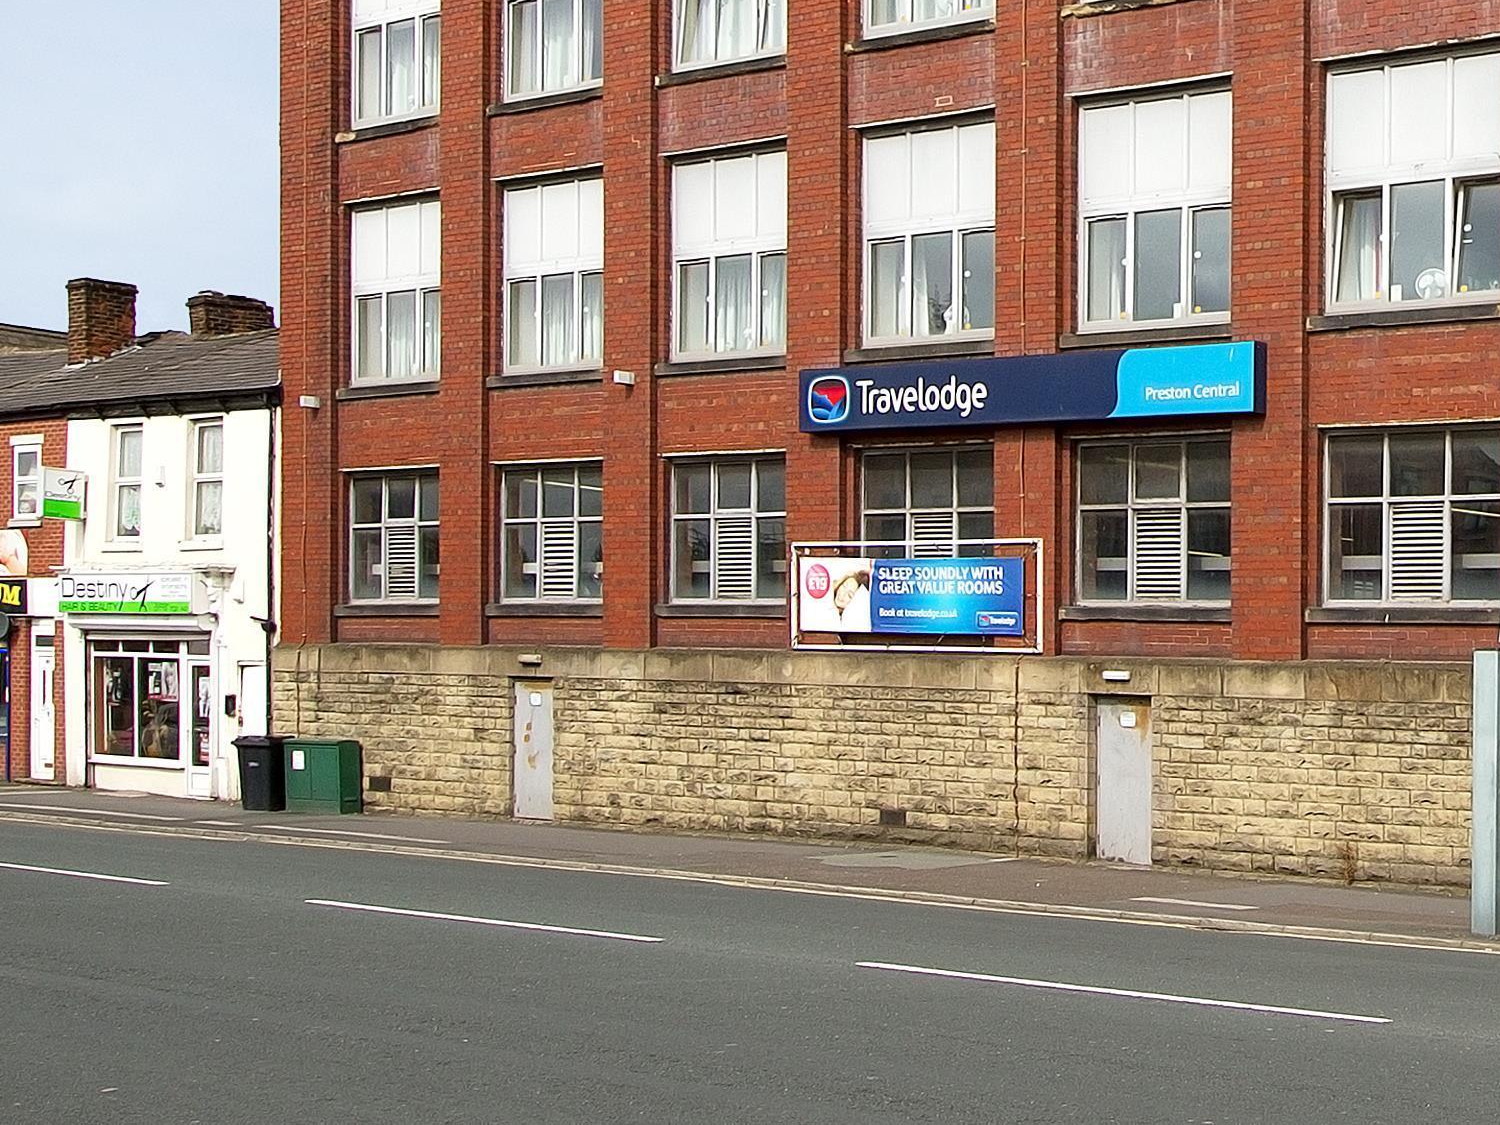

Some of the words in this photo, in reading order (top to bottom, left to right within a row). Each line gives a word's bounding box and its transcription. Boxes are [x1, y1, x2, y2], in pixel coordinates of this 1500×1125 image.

[855, 374, 988, 418] Travelodge
[1145, 386, 1191, 401] Preston
[1193, 379, 1240, 399] Central
[878, 567, 913, 580] SLEEP
[915, 566, 968, 580] SOUNDLY
[970, 566, 1003, 580] WITH
[61, 577, 128, 612] Destiny
[879, 581, 916, 594] GREAT
[916, 581, 955, 594] VALUE
[957, 581, 1003, 595] ROOMS
[88, 602, 119, 611] BEAUTY
[879, 608, 896, 617] Book
